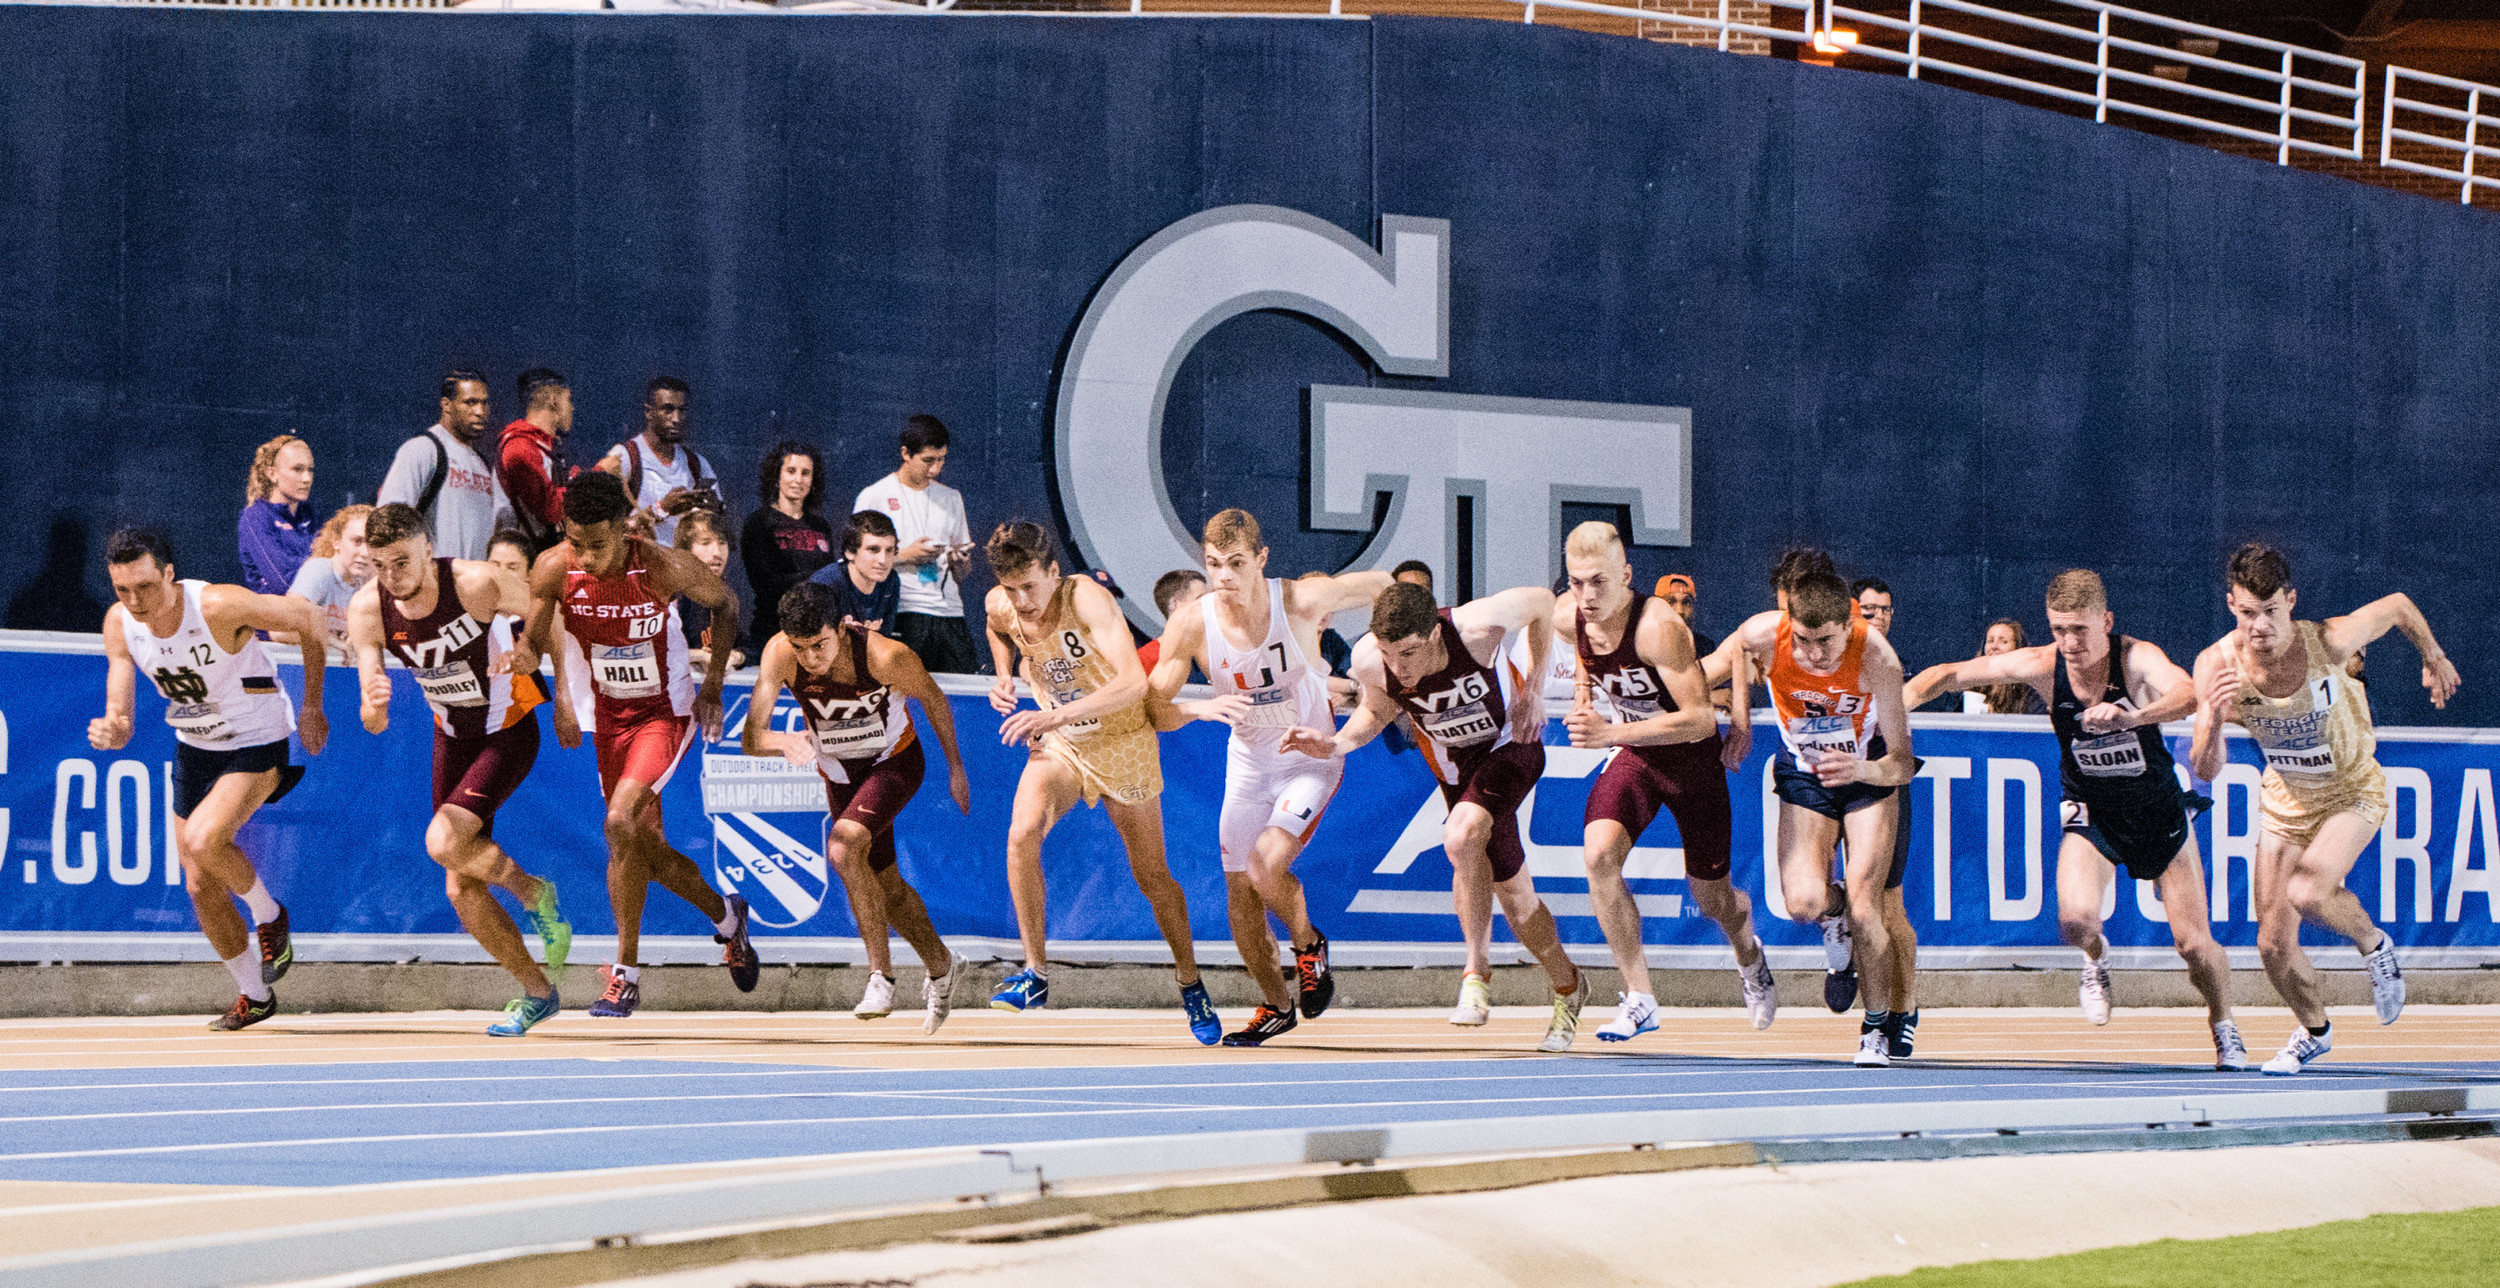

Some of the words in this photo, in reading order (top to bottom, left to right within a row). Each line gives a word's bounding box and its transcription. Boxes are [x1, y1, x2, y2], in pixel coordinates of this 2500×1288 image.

[571, 604, 593, 616] NC
[597, 601, 655, 618] STATE
[443, 618, 474, 647] 11
[637, 617, 659, 637] 10
[604, 644, 643, 660] ACC
[1064, 631, 1086, 658] 8
[189, 643, 216, 667] 12
[1268, 641, 1288, 672] 7
[604, 666, 648, 683] HALL
[1627, 670, 1649, 693] 5
[1463, 677, 1483, 699] 6
[2319, 679, 2332, 706] 1
[1840, 697, 1860, 713] 3
[1799, 716, 1843, 734] ACC
[821, 729, 885, 747] MOHAMMADI
[2273, 735, 2318, 751] ACC
[2078, 747, 2140, 766] SLOAN
[2267, 752, 2332, 767] PITTMAN
[710, 759, 752, 773] OUTDOOR
[754, 760, 783, 772] TRACK
[787, 761, 793, 772] &
[707, 782, 827, 806] CHAMPIONSHIPS
[2066, 803, 2083, 824] 2
[725, 865, 744, 882] 4
[751, 858, 773, 874] 3
[1685, 905, 1700, 918] TM
